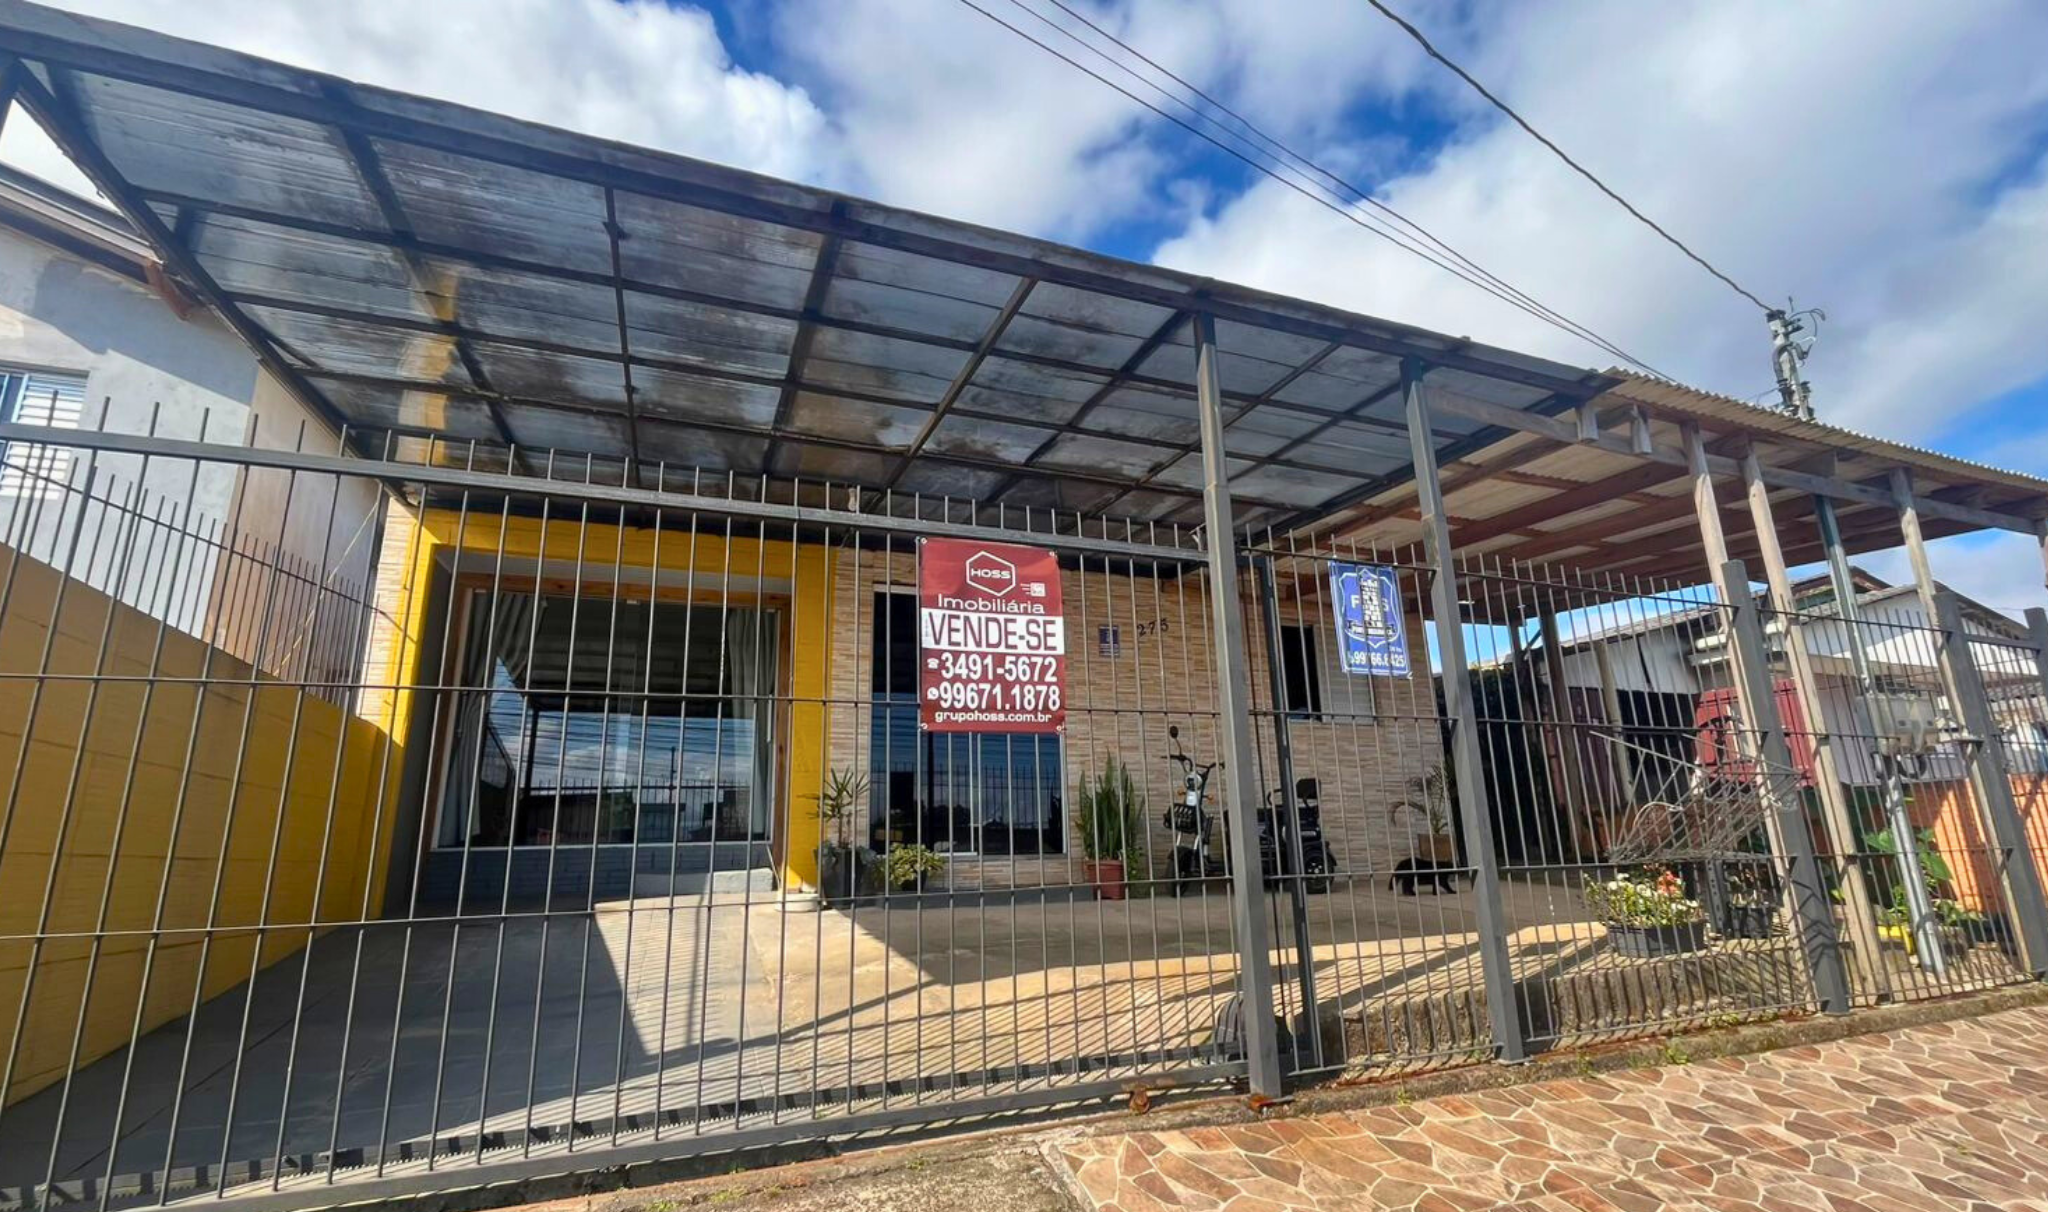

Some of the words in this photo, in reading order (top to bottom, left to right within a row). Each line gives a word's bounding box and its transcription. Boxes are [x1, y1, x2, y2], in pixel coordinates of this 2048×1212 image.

[971, 568, 1011, 580] HOSS
[937, 593, 1045, 614] Imobiliária
[928, 611, 1058, 651] VENDE-SE
[940, 652, 1058, 683] 3491-5672
[938, 682, 1060, 712] 99671.1878
[934, 710, 1053, 723] grupohoss.com.br
